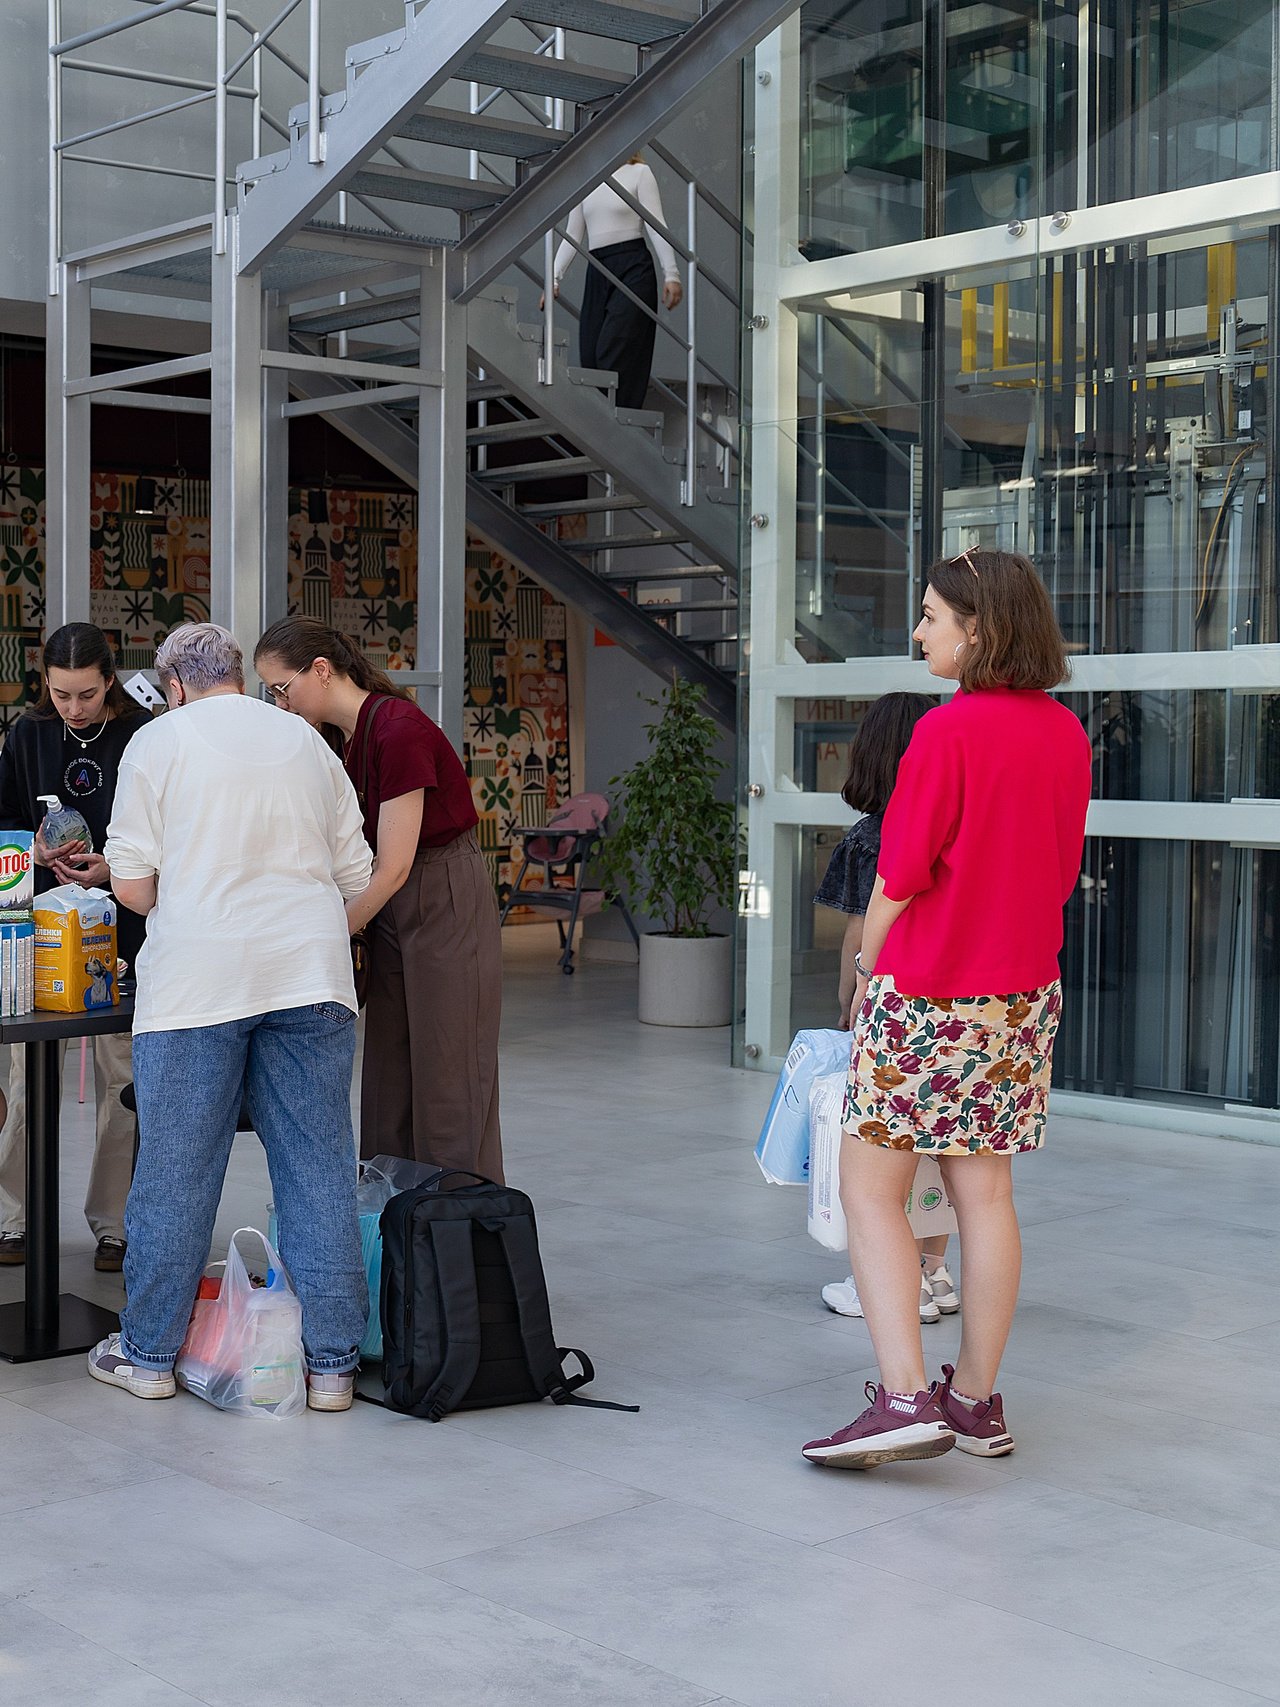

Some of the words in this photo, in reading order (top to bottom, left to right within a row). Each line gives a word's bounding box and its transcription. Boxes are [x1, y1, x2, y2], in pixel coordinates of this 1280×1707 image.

[34, 928, 62, 936] ЕЛЕНКИ
[82, 934, 112, 946] ПЕЛЕНКИ
[890, 1400, 918, 1414] PUMA
